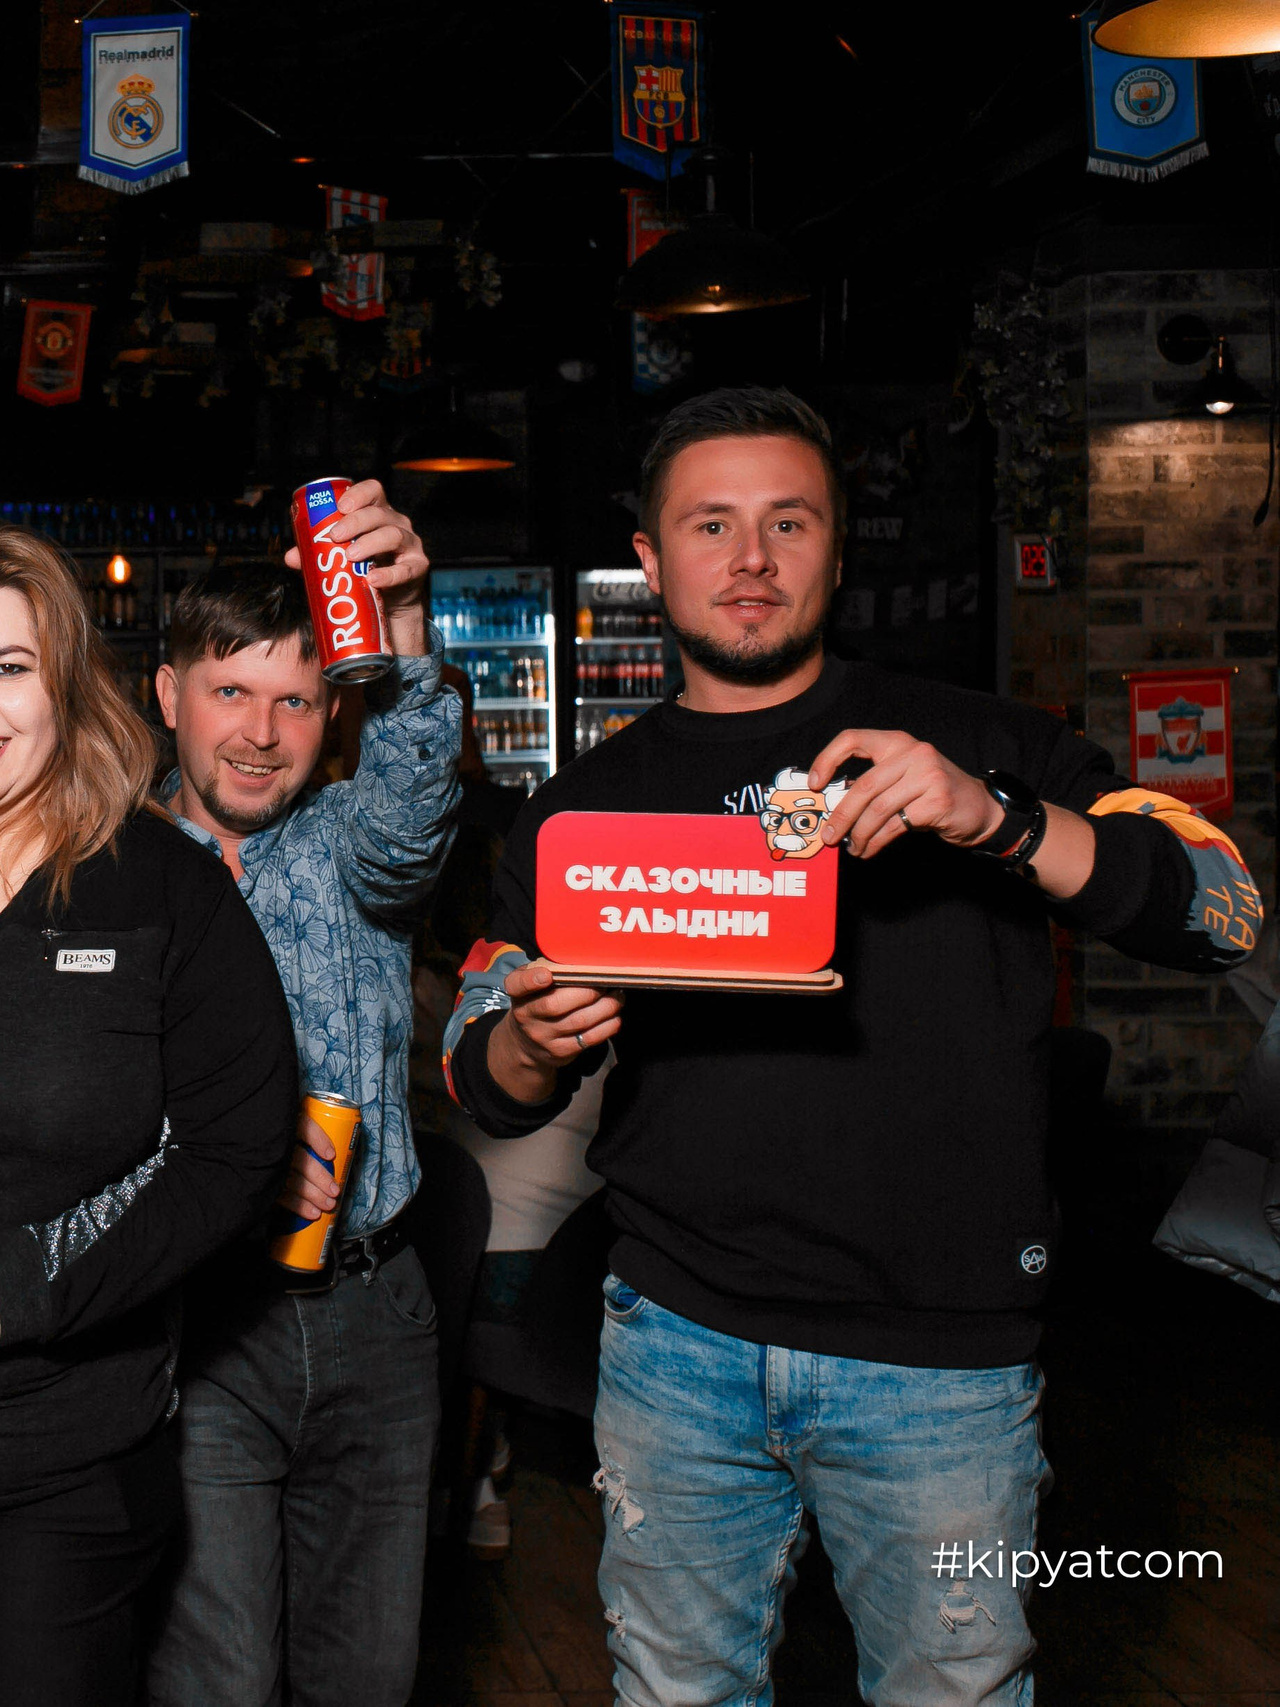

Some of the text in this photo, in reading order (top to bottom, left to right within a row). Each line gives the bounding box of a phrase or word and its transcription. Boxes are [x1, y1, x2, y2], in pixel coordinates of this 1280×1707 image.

[1118, 69, 1171, 92] MANCHESTER
[1136, 115, 1157, 125] CITY
[309, 490, 332, 501] AQUA
[308, 497, 334, 508] ROSSA
[565, 864, 807, 897] СКАЗОЧНЫЕ
[599, 906, 769, 939] ЗЛЫДНИ
[62, 953, 111, 965] BEAMS
